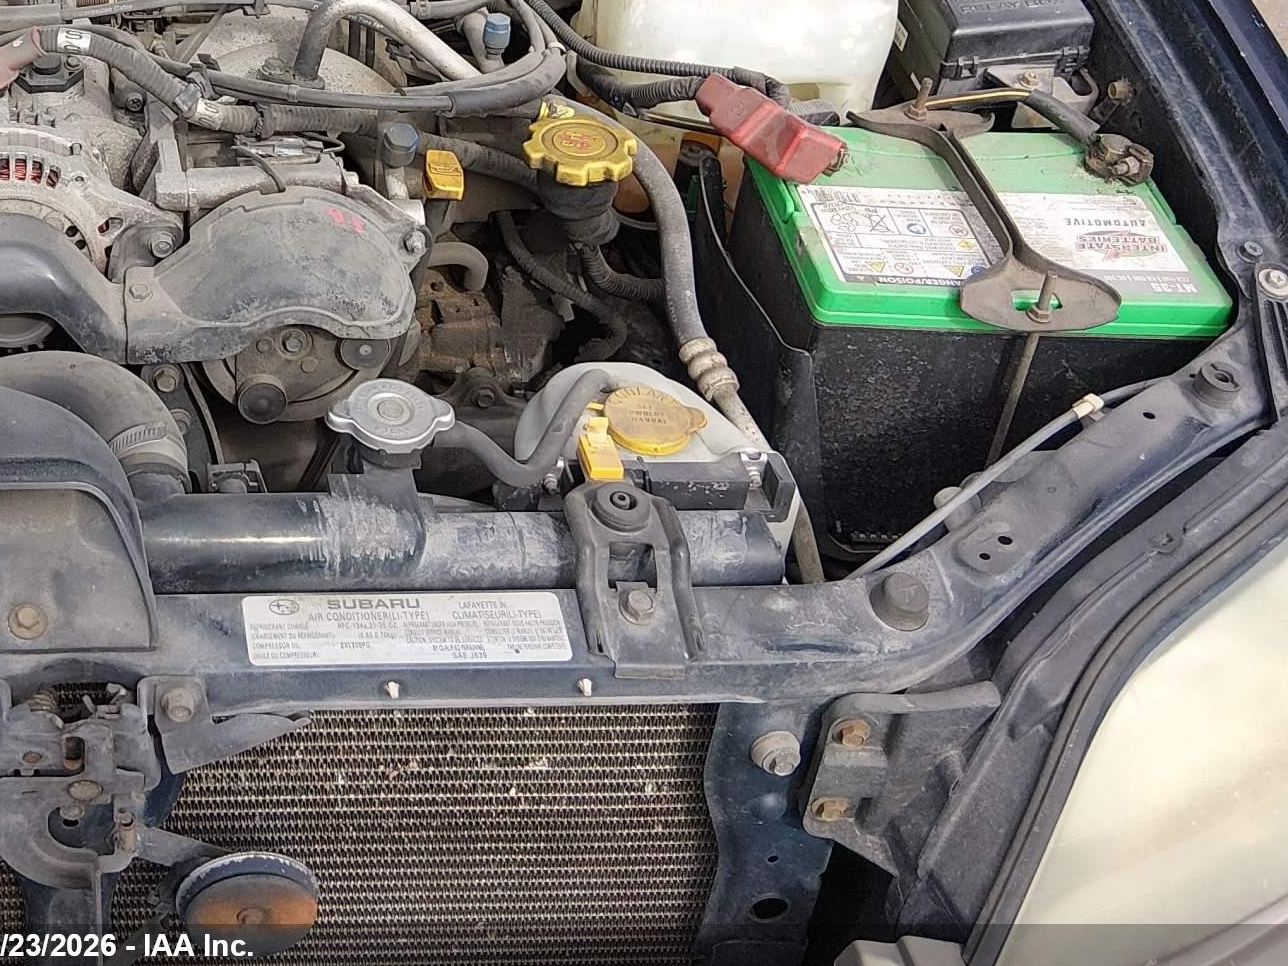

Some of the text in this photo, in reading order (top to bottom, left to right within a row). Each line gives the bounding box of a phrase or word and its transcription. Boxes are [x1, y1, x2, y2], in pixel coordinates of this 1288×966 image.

[1065, 217, 1146, 227] AUTOMOTIVE
[1078, 235, 1158, 244] BATTERIES
[1079, 242, 1165, 252] INTERSTATE
[878, 276, 961, 288] ANGER/POISON
[327, 598, 420, 610] SUBARU
[459, 601, 497, 609] LAFAYETTE
[309, 613, 323, 622] AIR
